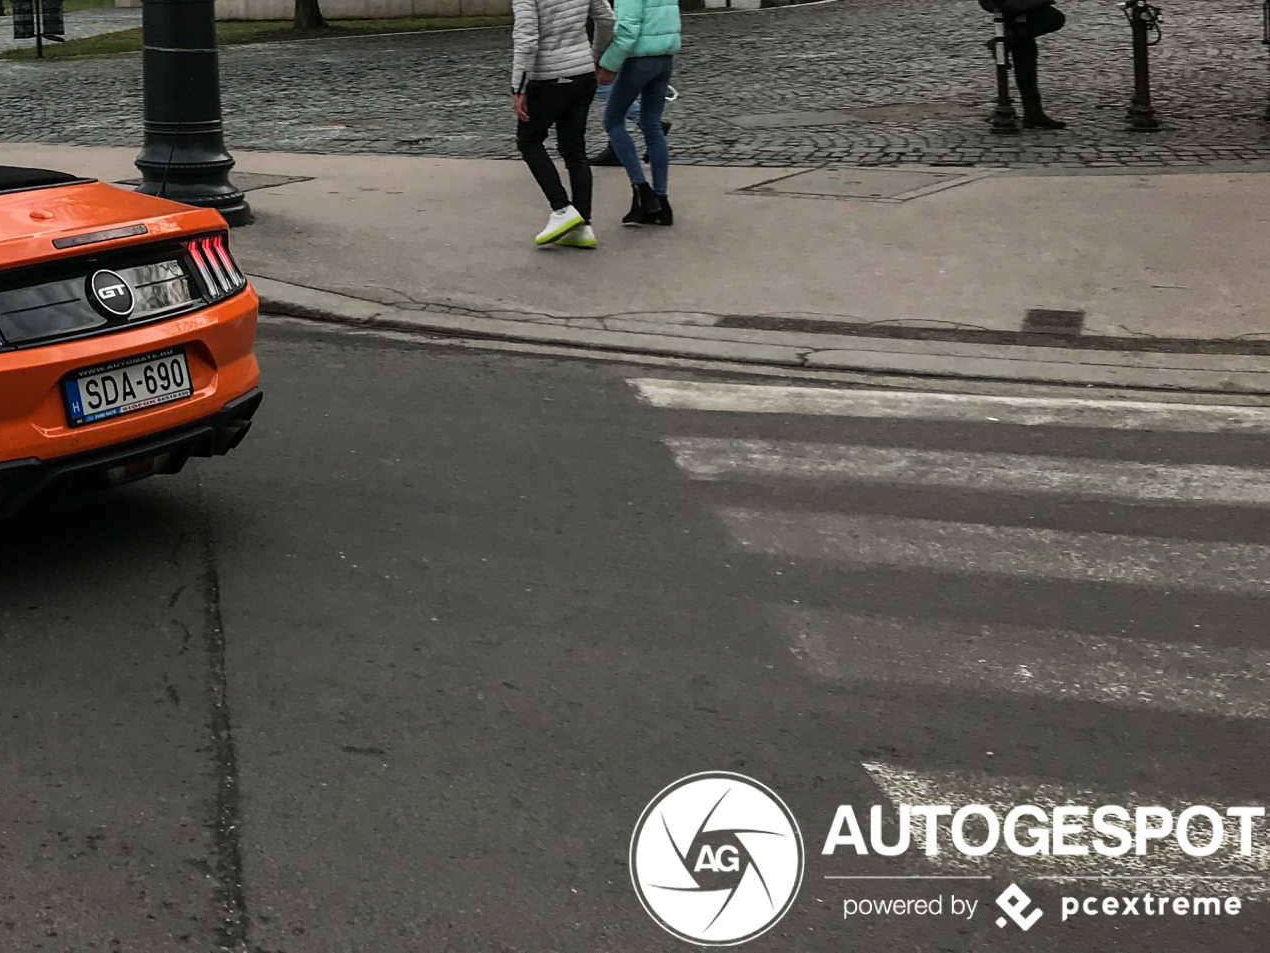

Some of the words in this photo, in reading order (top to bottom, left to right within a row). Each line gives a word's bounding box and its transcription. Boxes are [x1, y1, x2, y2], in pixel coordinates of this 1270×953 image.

[98, 283, 126, 300] GT
[78, 349, 174, 377] WWW.AUTOMATE.HU
[85, 358, 185, 409] SDA-690
[71, 401, 81, 414] H
